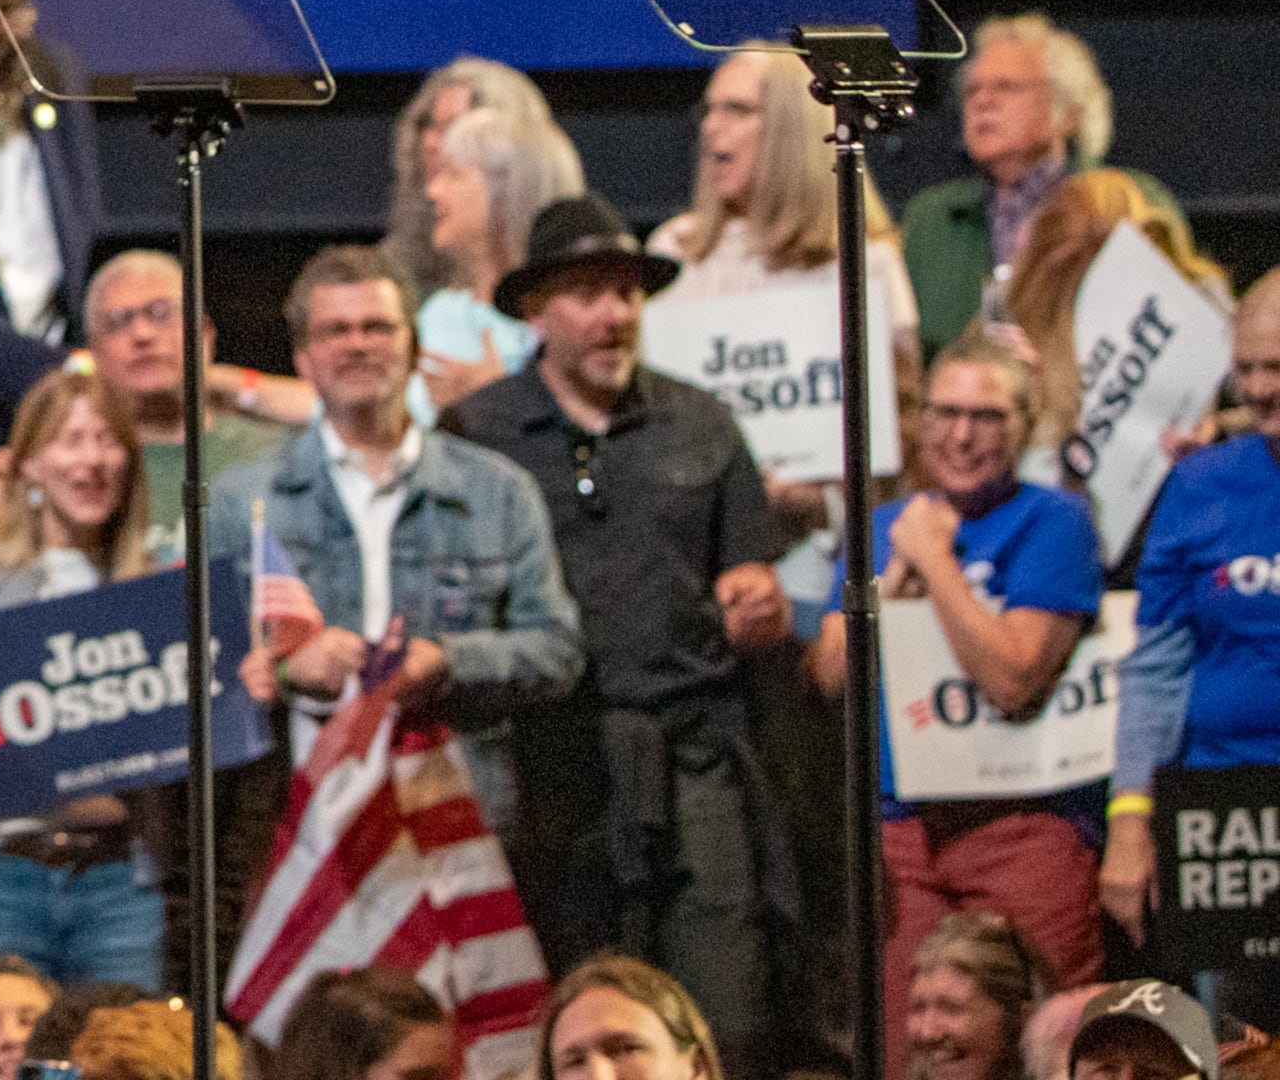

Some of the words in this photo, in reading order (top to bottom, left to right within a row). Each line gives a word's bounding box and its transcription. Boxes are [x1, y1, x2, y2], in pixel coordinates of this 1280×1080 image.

[703, 335, 787, 375] Jon
[1060, 295, 1175, 479] Ossoff
[42, 628, 150, 685] Jon
